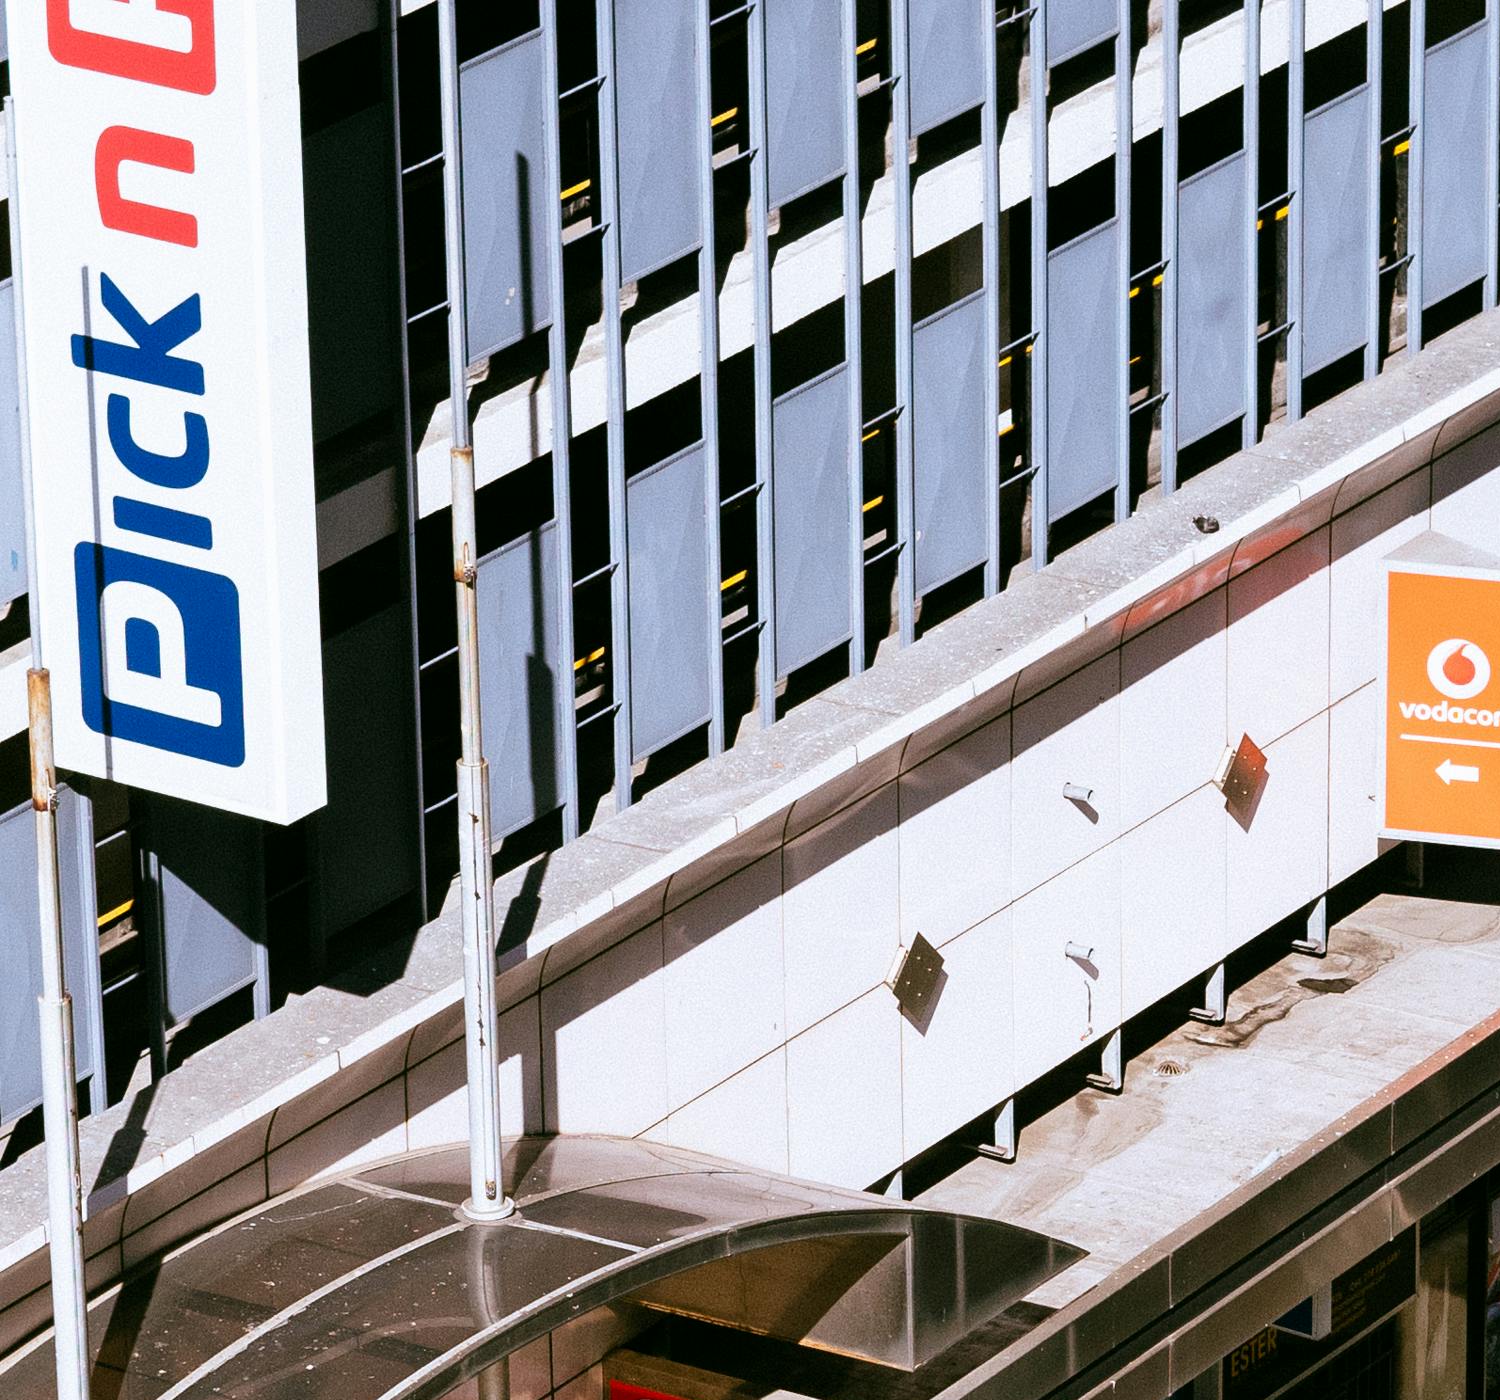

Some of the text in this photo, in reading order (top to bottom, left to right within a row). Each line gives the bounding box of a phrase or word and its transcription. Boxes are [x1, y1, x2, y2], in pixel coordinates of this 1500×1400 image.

[93, 124, 200, 249] n
[70, 269, 247, 769] Pick
[1231, 1328, 1278, 1377] ESTER
